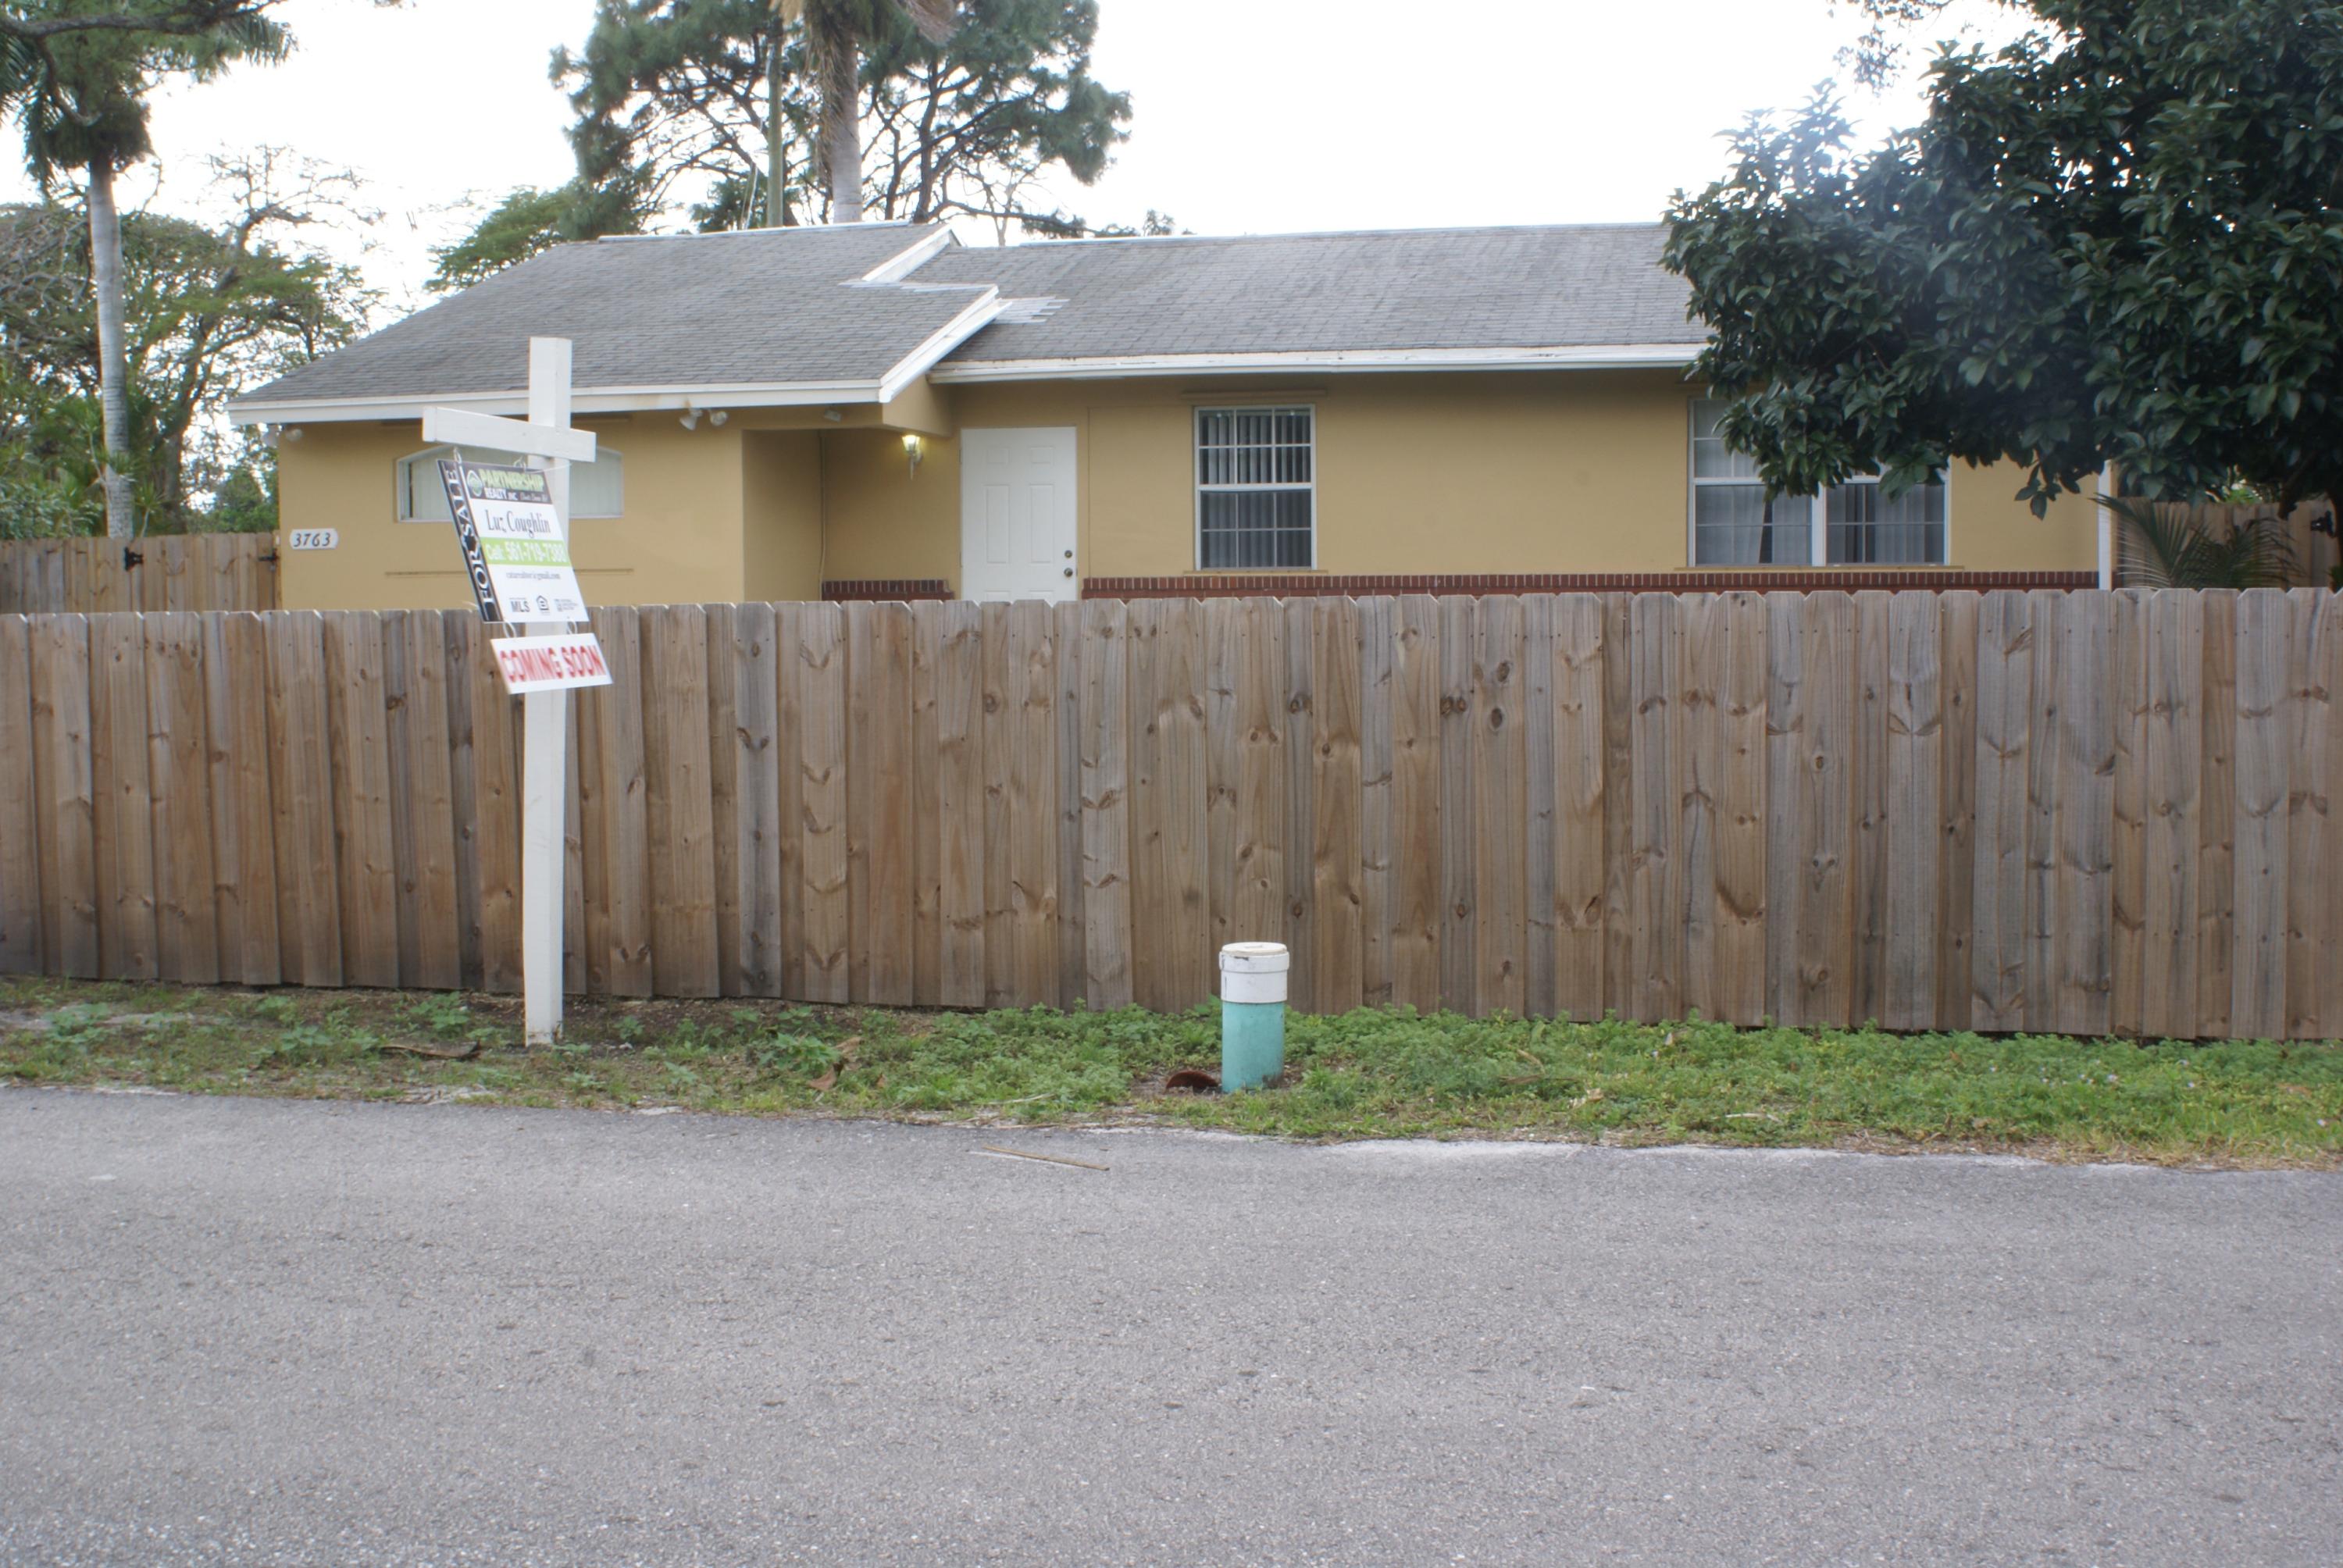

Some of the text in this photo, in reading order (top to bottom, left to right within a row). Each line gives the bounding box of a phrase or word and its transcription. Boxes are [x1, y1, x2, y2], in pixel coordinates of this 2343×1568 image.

[478, 469, 544, 492] PARTNERSHIP
[484, 487, 508, 500] REALTY
[485, 509, 551, 538] Luz Coughlin
[294, 533, 331, 547] 3763
[445, 469, 494, 603] FOR SALE
[511, 600, 530, 613] MLS
[500, 645, 607, 682] COMING SOON
